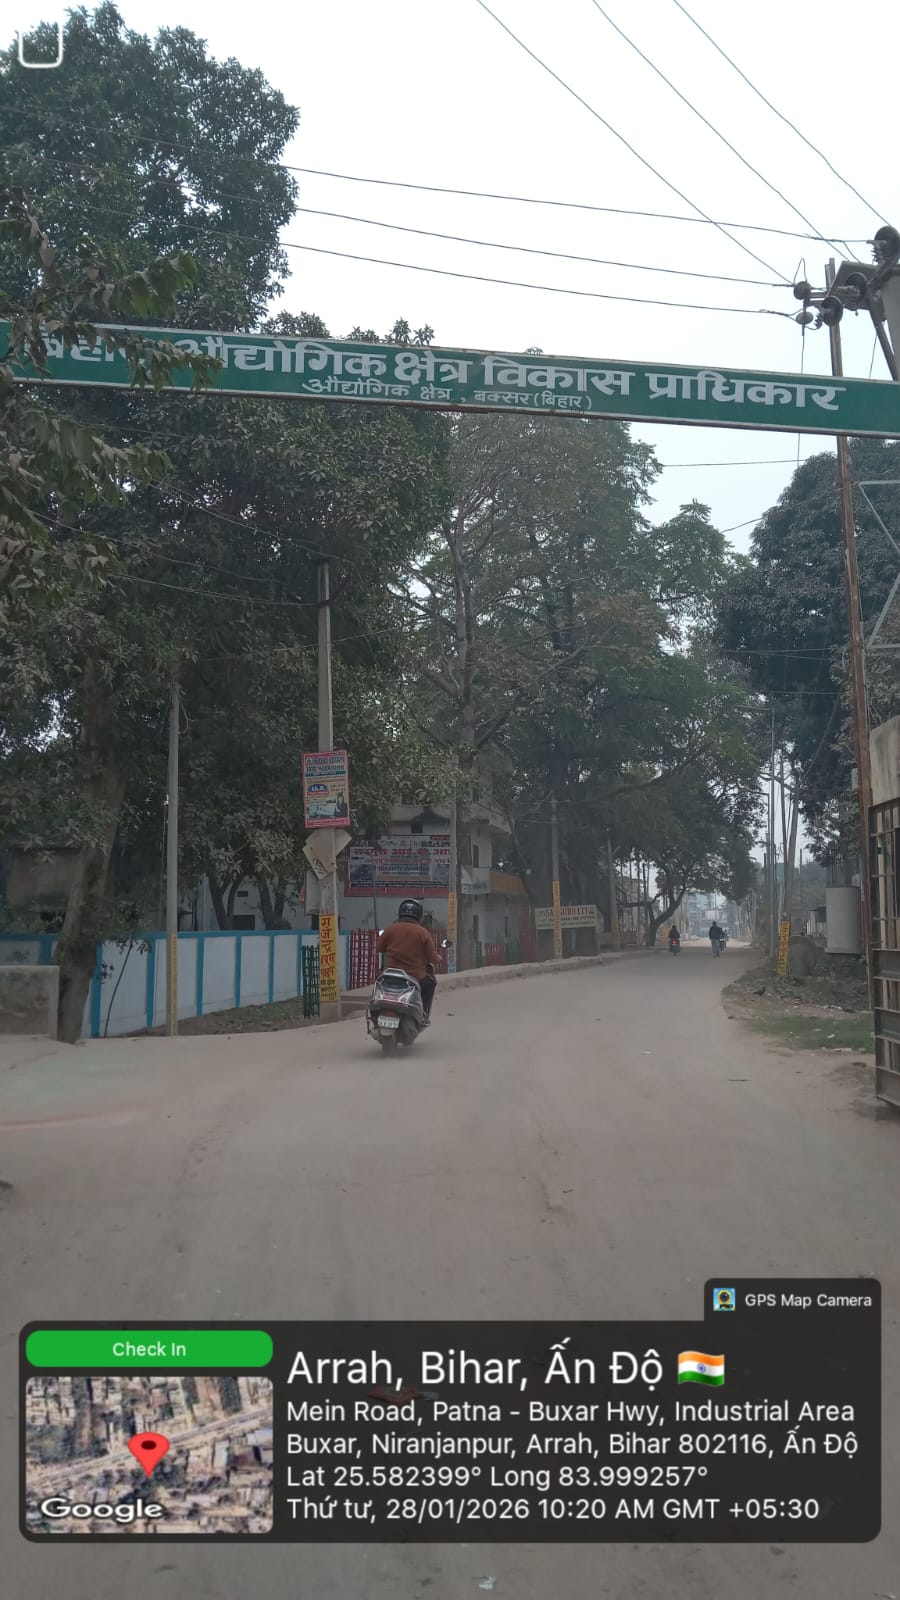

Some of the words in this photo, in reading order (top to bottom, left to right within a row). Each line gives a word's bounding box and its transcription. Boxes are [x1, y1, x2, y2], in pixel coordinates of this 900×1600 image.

[301, 376, 410, 397] औद्योगिक
[392, 349, 473, 385] क्षेत्र
[481, 355, 635, 396] विकास
[645, 371, 847, 411] प्राधिकार
